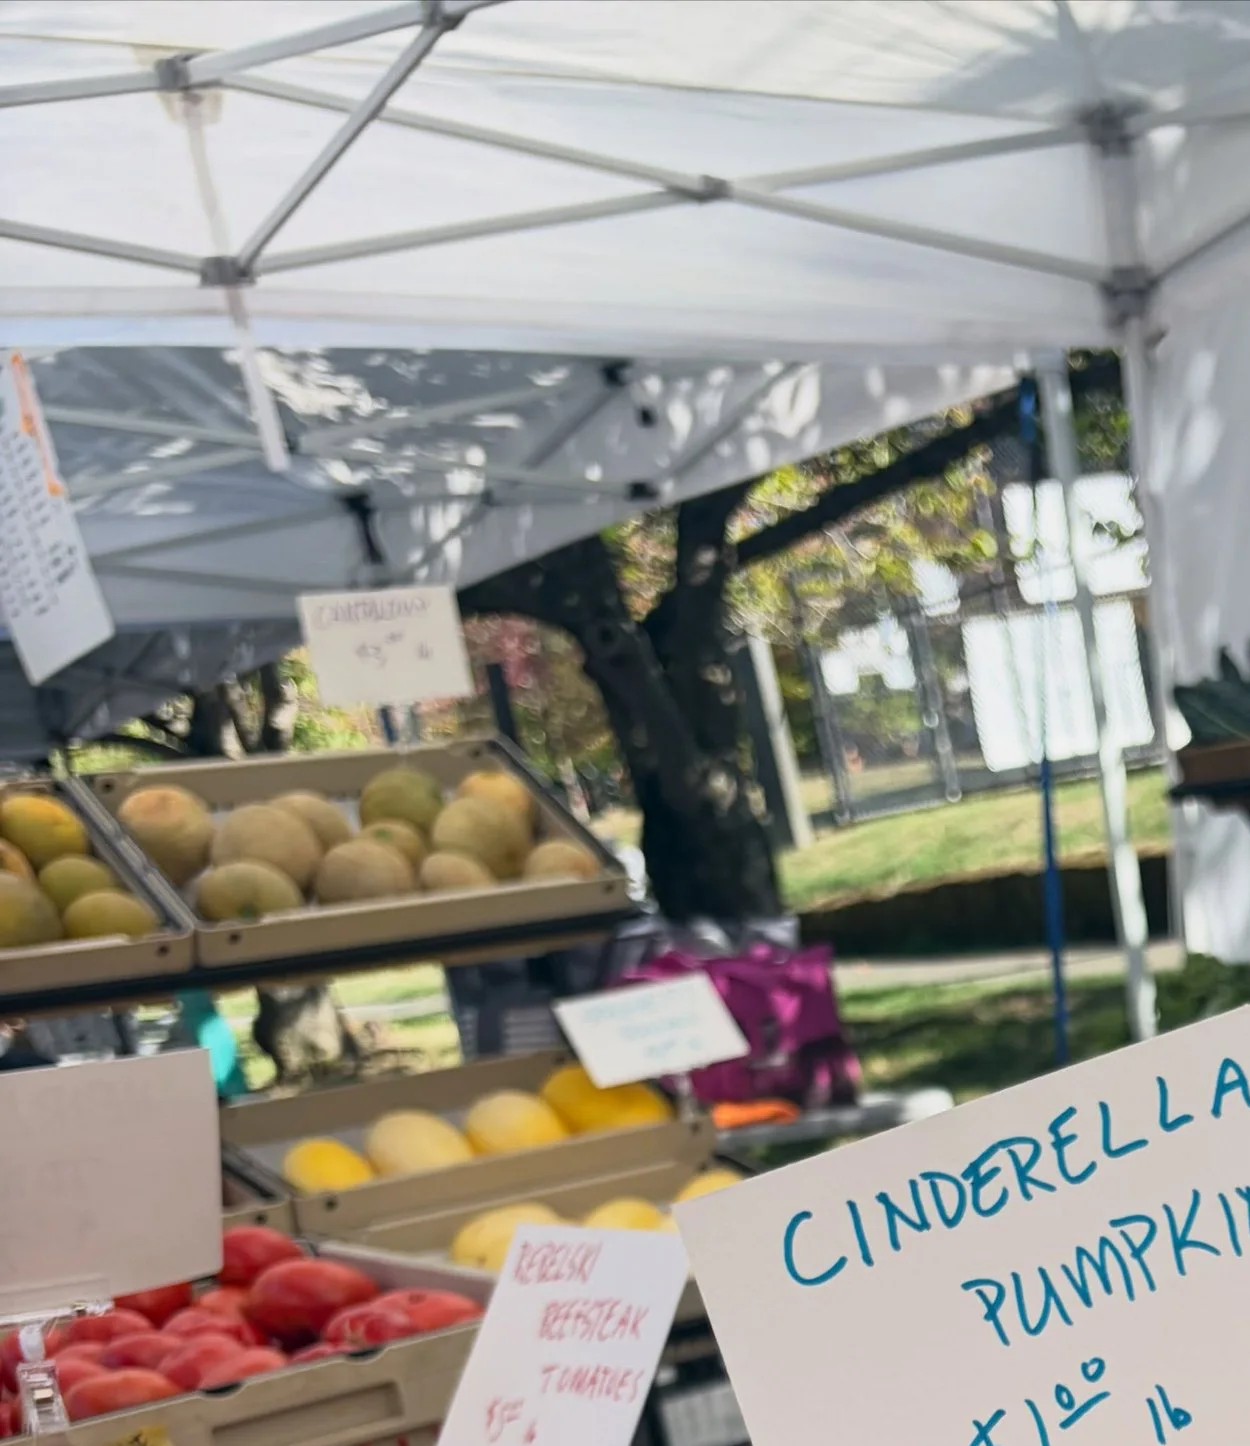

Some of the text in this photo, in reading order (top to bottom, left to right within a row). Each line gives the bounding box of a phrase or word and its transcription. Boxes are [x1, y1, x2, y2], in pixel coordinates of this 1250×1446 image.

[537, 1297, 650, 1342] BEEFSTEAK
[540, 1363, 645, 1404] TOMATOES
[1147, 1386, 1191, 1444] lb
